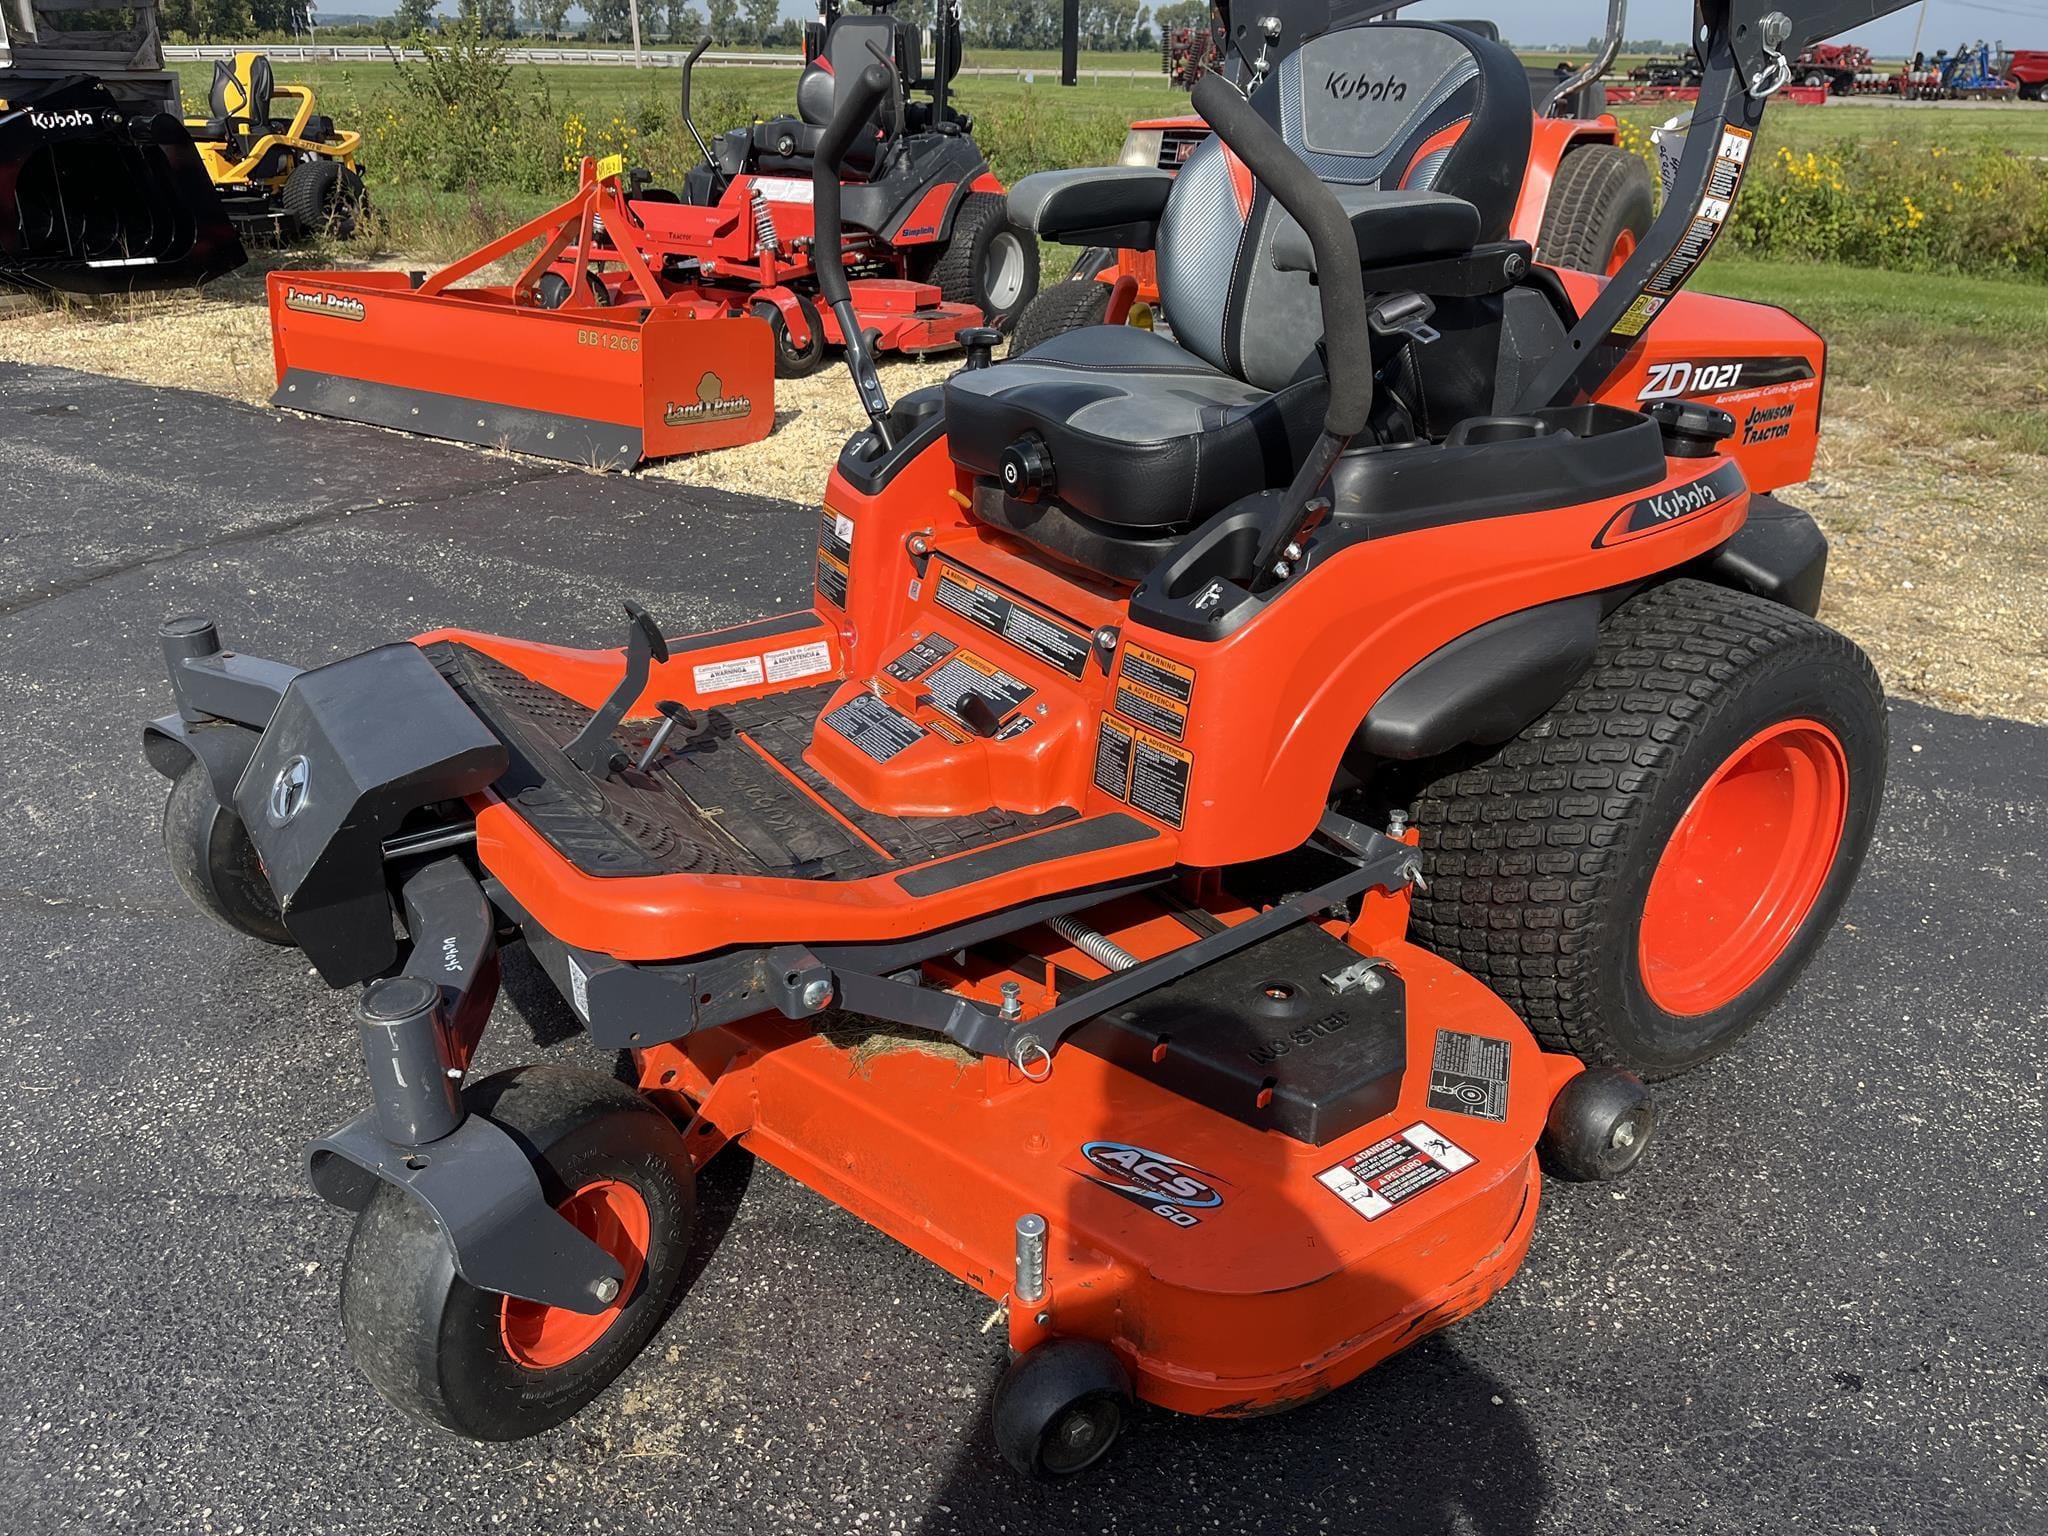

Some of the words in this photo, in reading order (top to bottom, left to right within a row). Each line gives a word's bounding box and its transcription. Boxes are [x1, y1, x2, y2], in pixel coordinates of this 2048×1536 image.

[1325, 71, 1407, 102] Kubota
[30, 109, 94, 130] Kubota
[286, 285, 323, 307] Land
[325, 292, 365, 313] Pride
[577, 329, 640, 353] BB1266
[1714, 388, 1762, 405] Aerodynamic
[1762, 385, 1789, 399] Cutting
[1789, 382, 1815, 394] System
[666, 401, 703, 421] Land
[713, 395, 752, 417] Pride
[1744, 403, 1795, 427] JOHNSON
[1741, 423, 1791, 446] TRACTOR
[1648, 481, 1717, 520] Kubota
[778, 651, 816, 664] ADVERTENCIA
[1145, 653, 1177, 672] WARNING
[714, 668, 743, 678] WARNING
[1133, 683, 1176, 710] ADVERTENCIA
[1148, 738, 1185, 759] ADVERTENCIA
[1359, 1138, 1396, 1159] DANGER
[1098, 1150, 1209, 1198] ACS
[1383, 1159, 1423, 1182] PELIGRO
[1152, 1204, 1199, 1227] 60
